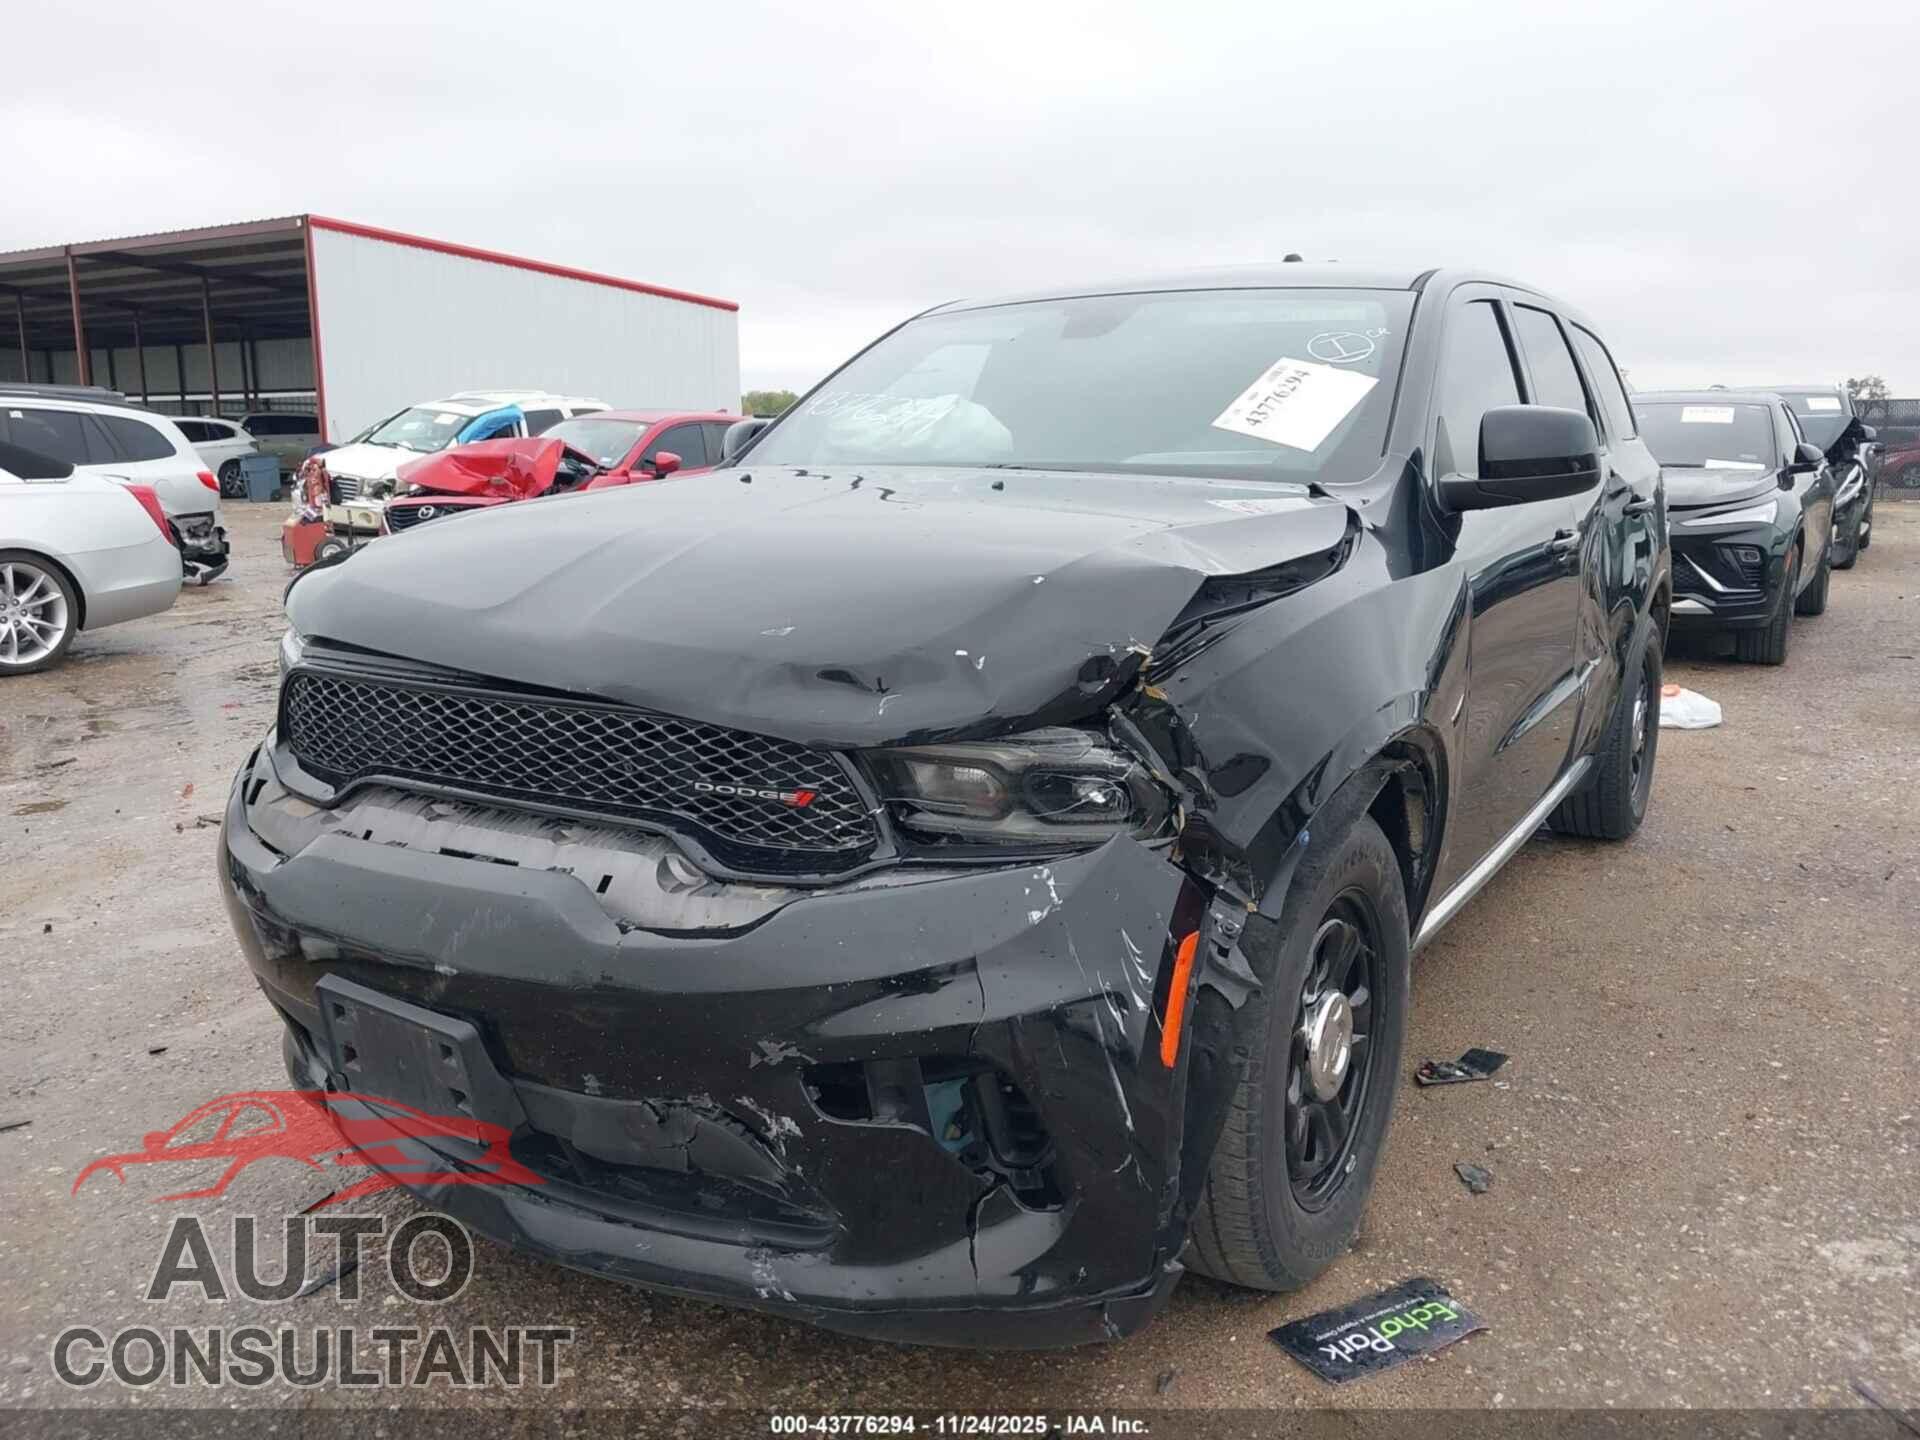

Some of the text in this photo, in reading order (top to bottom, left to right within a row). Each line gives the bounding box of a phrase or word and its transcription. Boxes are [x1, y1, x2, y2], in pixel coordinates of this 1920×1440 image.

[1245, 368, 1311, 427] 43776294
[694, 782, 799, 800] DODGE
[1319, 1302, 1459, 1362] EchoPark
